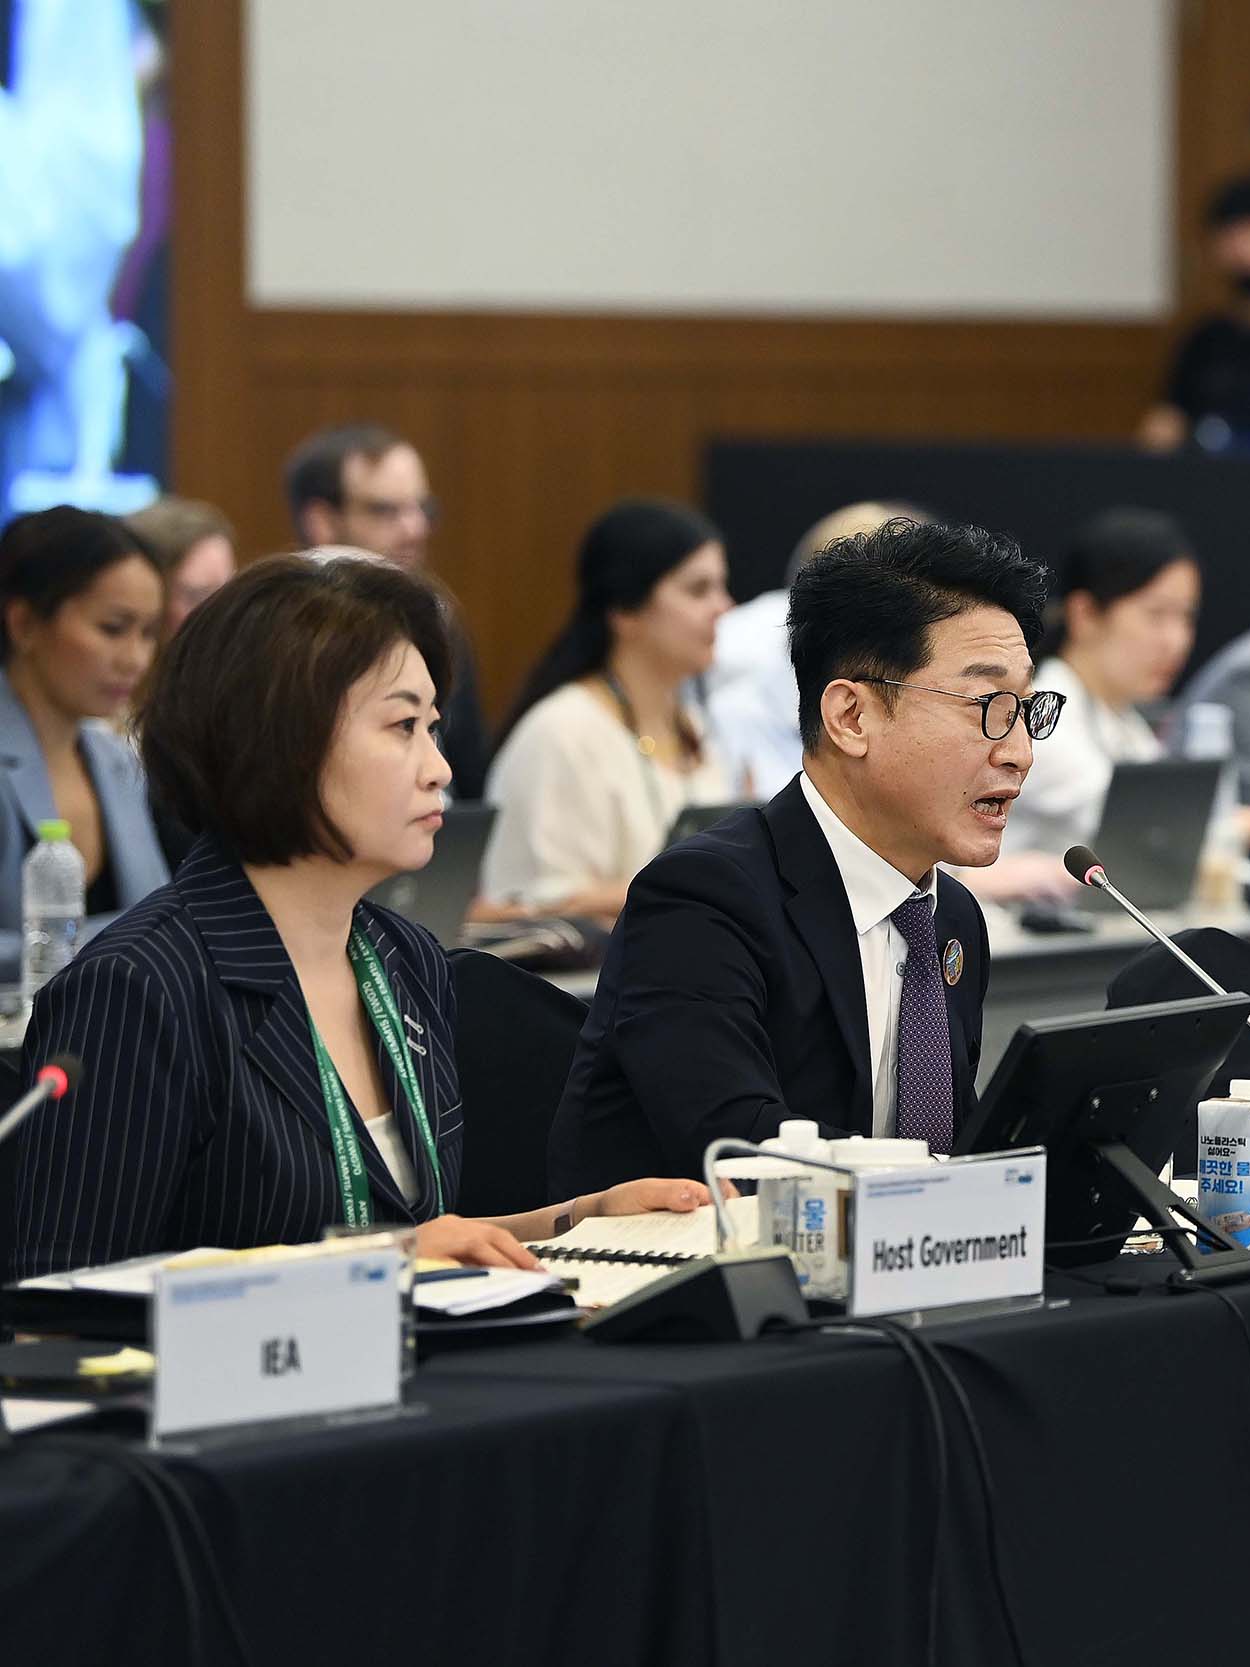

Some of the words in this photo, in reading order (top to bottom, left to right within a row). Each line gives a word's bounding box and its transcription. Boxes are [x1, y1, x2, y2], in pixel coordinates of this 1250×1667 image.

[1201, 1178, 1243, 1194] 주세요!
[873, 1237, 914, 1273] Host
[920, 1225, 1027, 1267] Government
[261, 1336, 302, 1377] IEA
